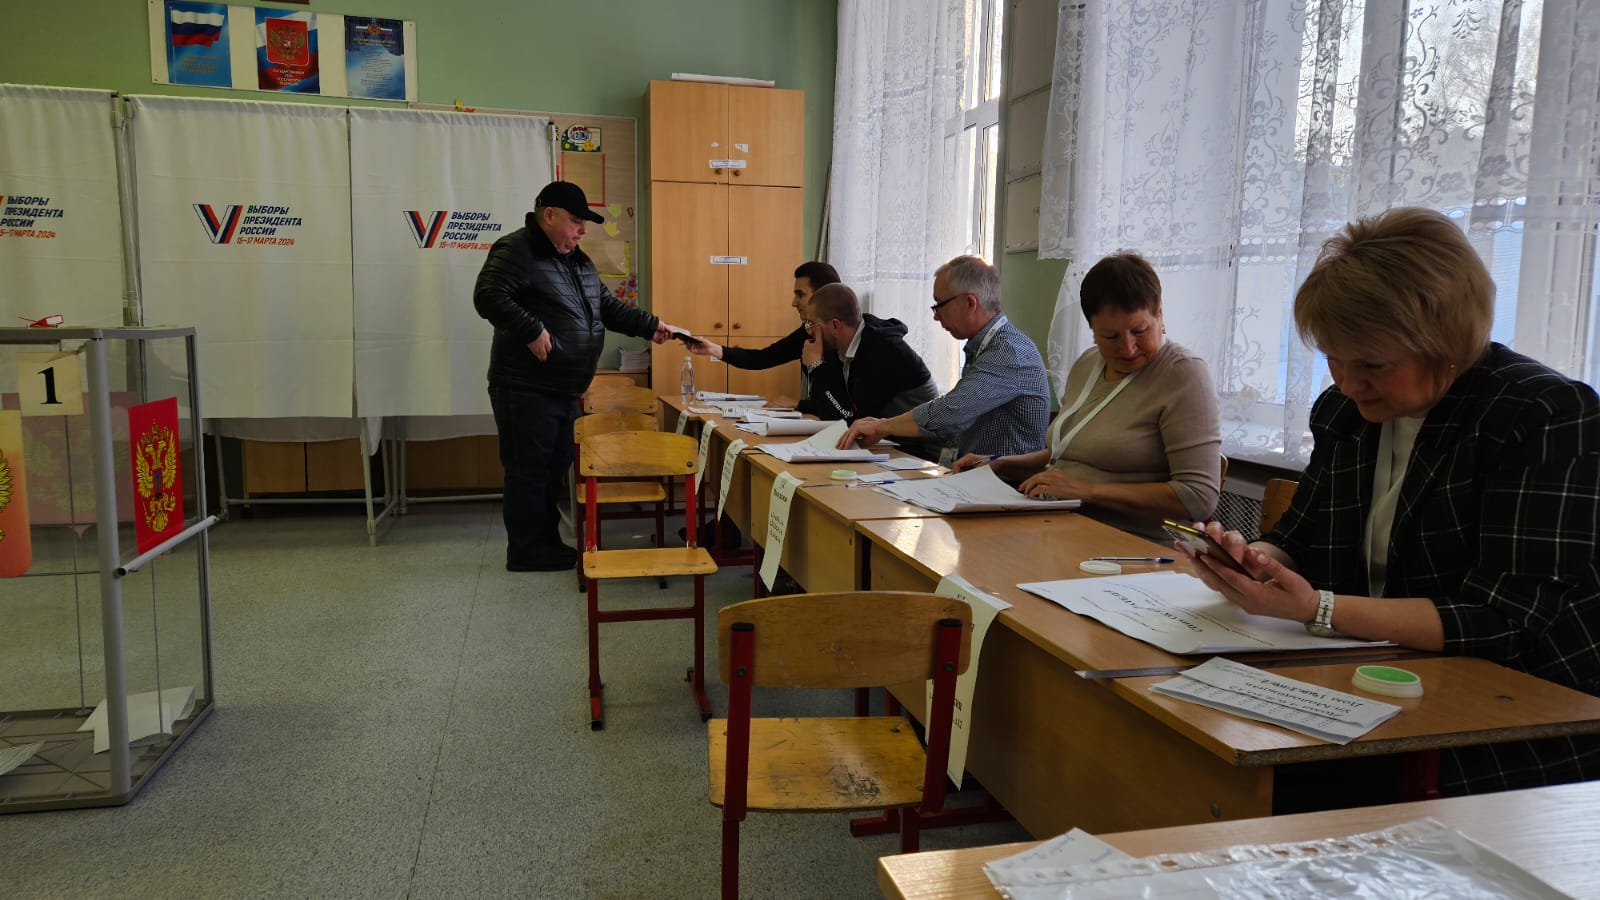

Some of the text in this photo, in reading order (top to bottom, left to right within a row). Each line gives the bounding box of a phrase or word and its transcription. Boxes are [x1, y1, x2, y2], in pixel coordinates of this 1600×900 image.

[247, 205, 290, 215] ВЫБОРЫ
[243, 216, 302, 226] ПРЕЗИДЕНТА
[451, 211, 491, 221] ВЫБОРЫ
[239, 227, 277, 236] РОССИИ
[447, 222, 502, 232] ПРЕЗИДЕНТА
[253, 236, 277, 245] МАРТА
[277, 238, 295, 246] 2024
[442, 232, 479, 240] РОССИИ
[457, 242, 478, 250] МАРТА
[478, 242, 493, 250] 202
[37, 366, 64, 404] 1
